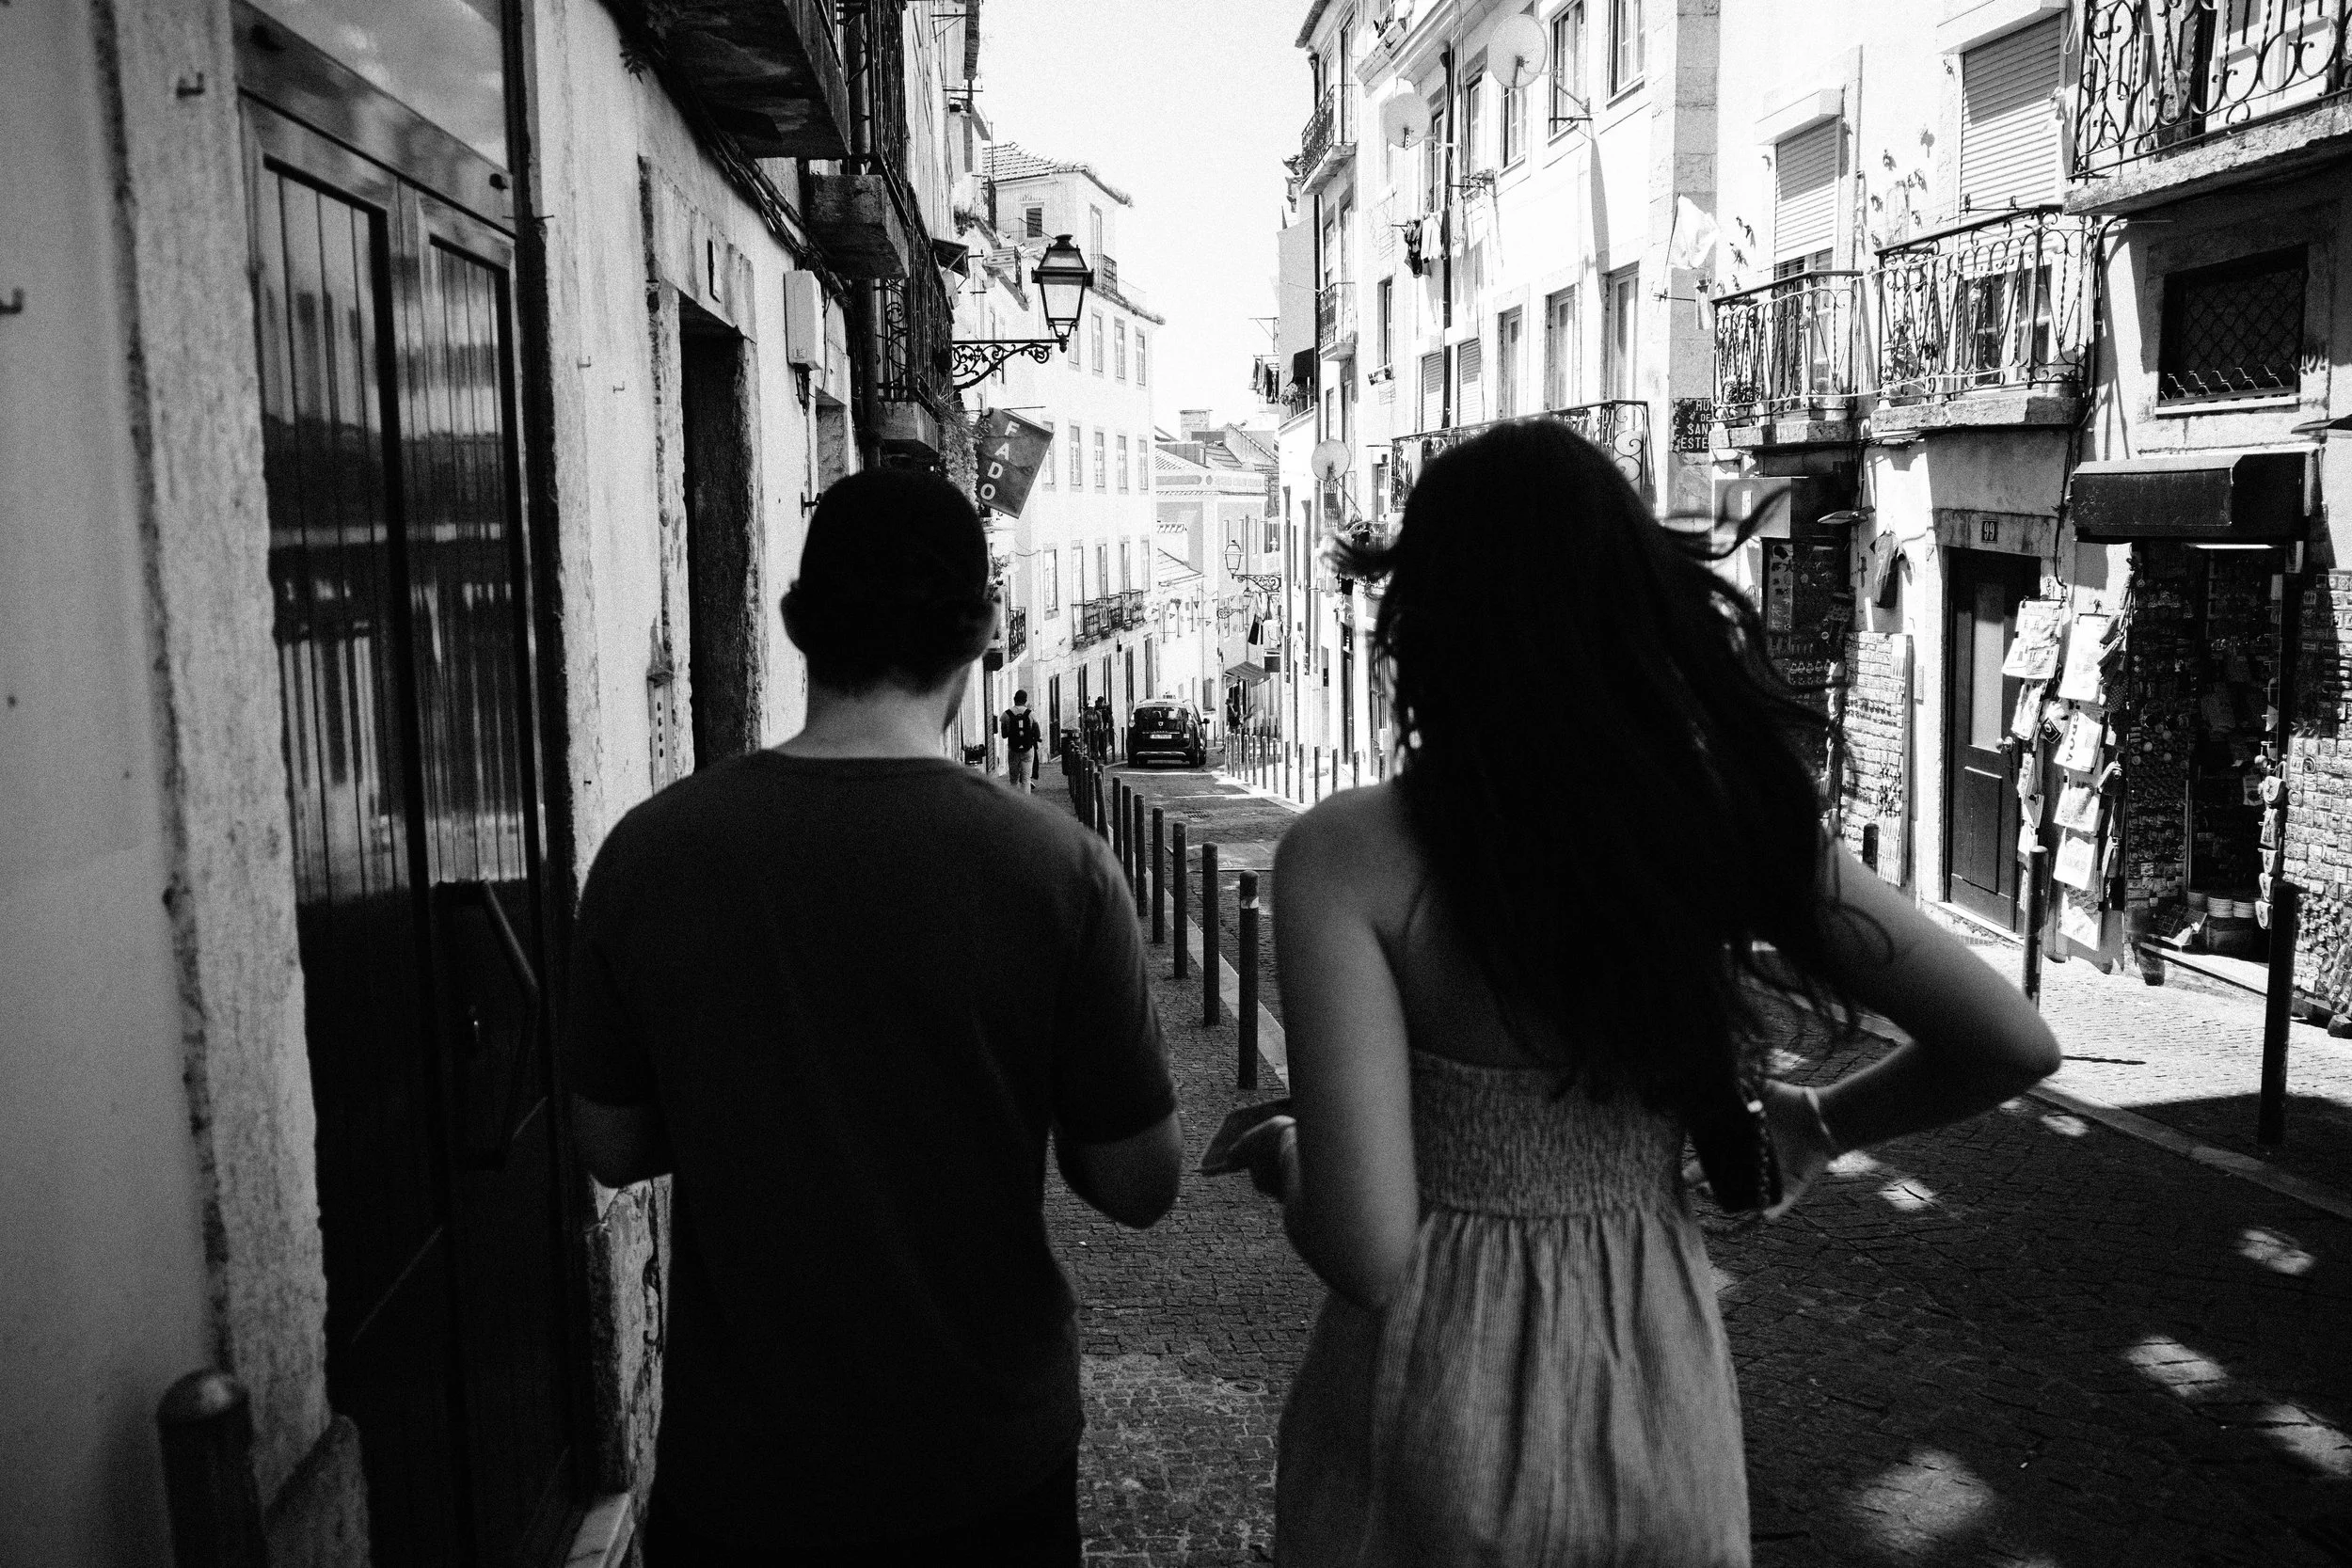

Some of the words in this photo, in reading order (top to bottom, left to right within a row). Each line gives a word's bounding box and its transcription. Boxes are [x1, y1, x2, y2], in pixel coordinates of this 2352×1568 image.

[1695, 399, 1711, 411] RU
[1700, 413, 1711, 422] DE
[1687, 422, 1714, 436] SANT
[1680, 435, 1708, 450] ESTÊ
[980, 420, 1020, 500] FADO
[1984, 521, 1994, 541] 99
